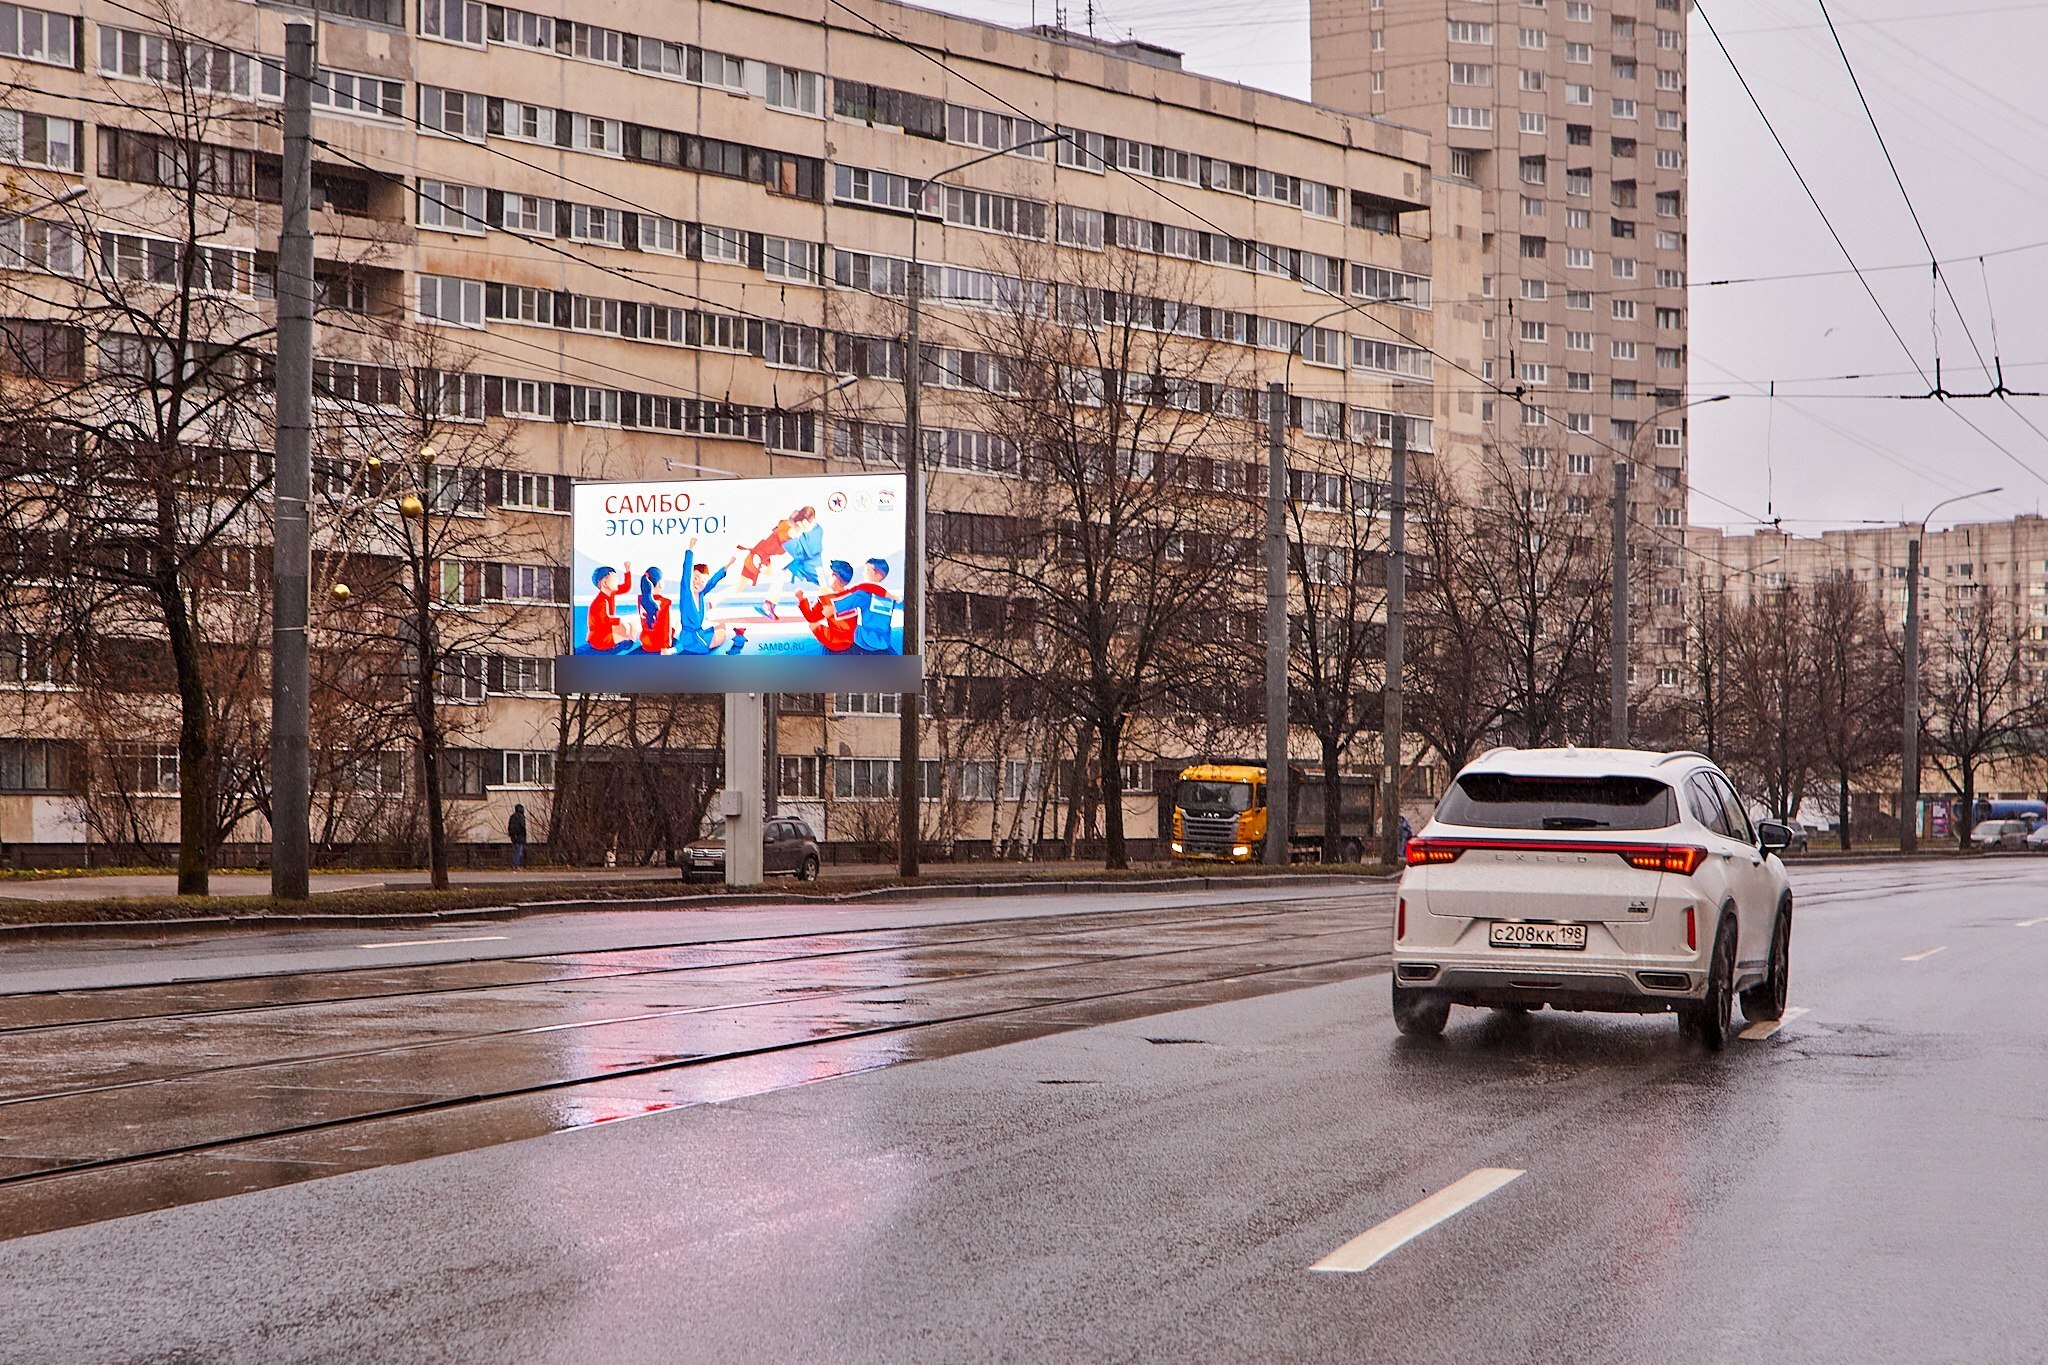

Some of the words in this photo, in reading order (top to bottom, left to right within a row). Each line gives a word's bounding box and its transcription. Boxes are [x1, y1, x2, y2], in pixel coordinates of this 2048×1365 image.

[605, 493, 690, 514] САМБО
[605, 518, 644, 536] ЭТО
[652, 515, 726, 535] КРУТО!
[758, 642, 805, 651] SAMBO.RU
[1560, 927, 1582, 939] 198
